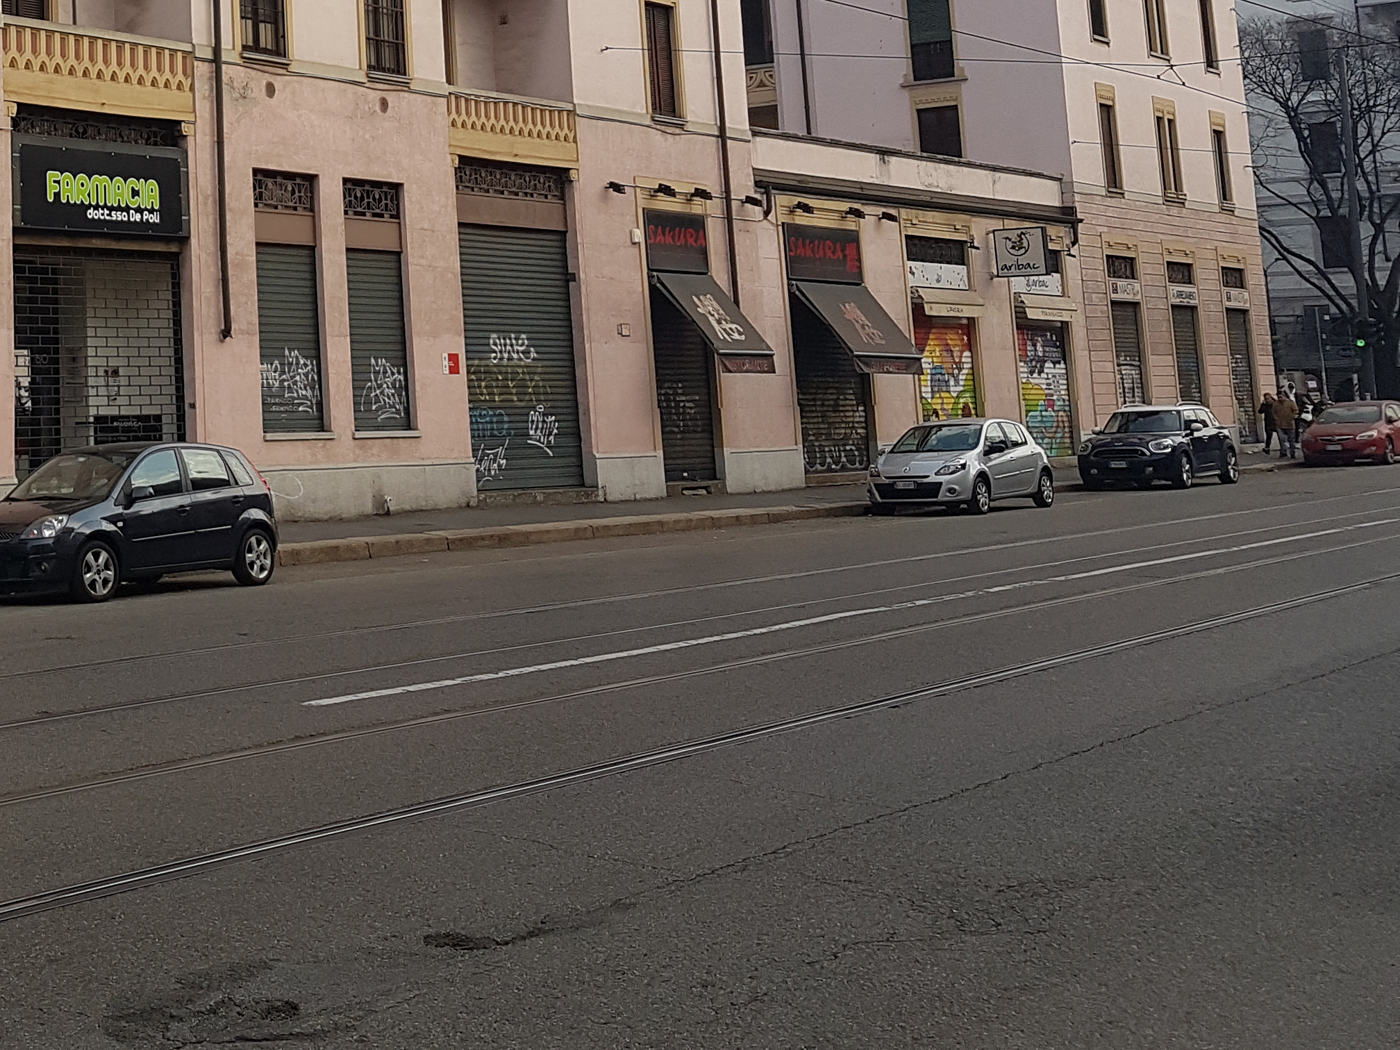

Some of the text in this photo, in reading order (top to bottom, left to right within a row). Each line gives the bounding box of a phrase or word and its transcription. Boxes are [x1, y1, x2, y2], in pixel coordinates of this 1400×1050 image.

[46, 170, 160, 209] FARMACIA
[86, 207, 160, 223] dott.ssa De Poli
[648, 225, 707, 247] SAKURA
[789, 236, 843, 260] SAKURA
[1001, 257, 1040, 272] aribac
